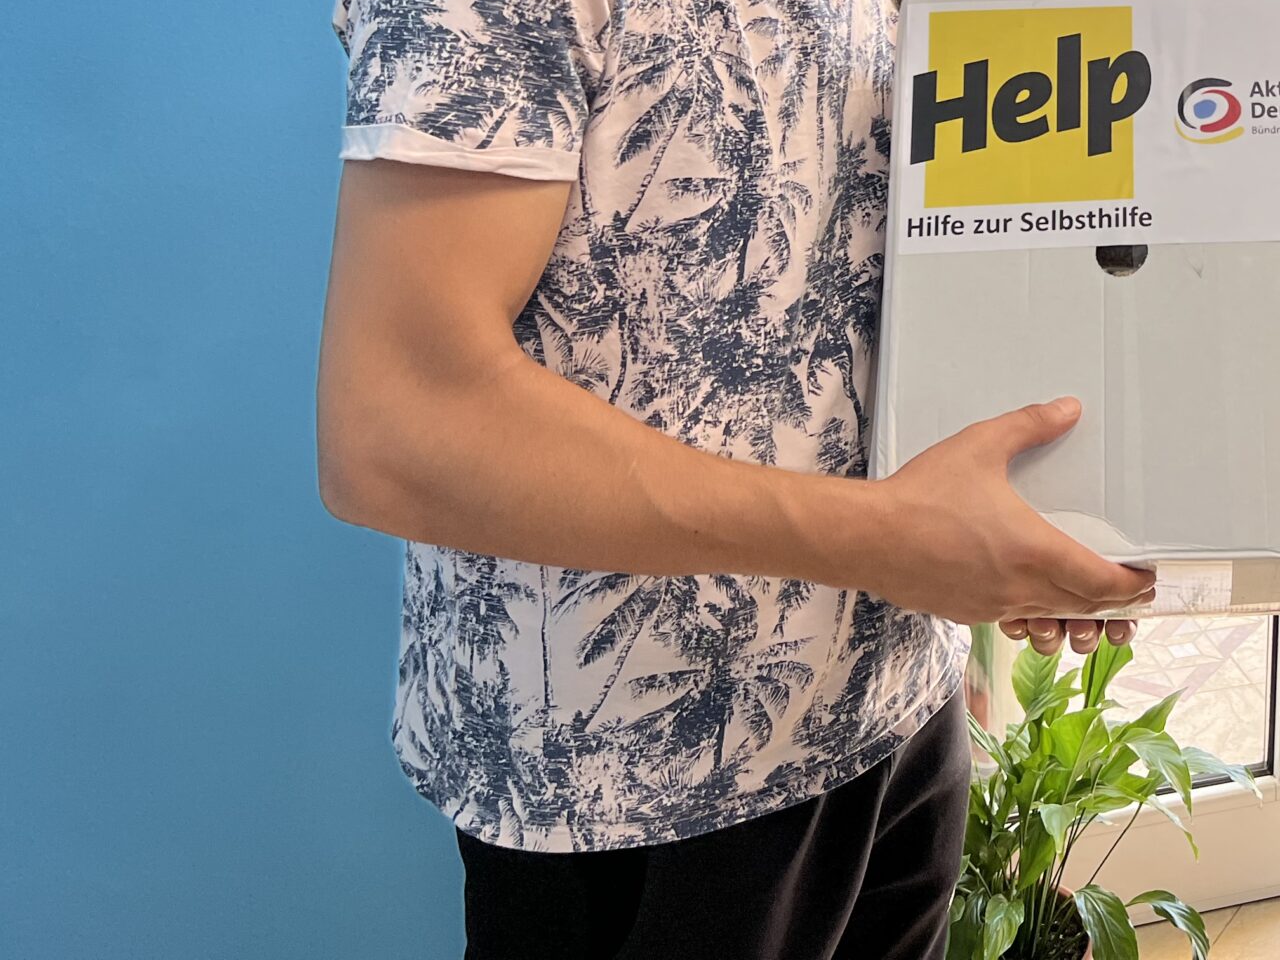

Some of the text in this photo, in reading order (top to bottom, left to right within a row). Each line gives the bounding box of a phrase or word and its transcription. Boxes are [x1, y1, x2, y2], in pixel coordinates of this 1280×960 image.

[910, 32, 1152, 165] Help
[907, 206, 1153, 238] Hilfe zur Selbsthilfe
